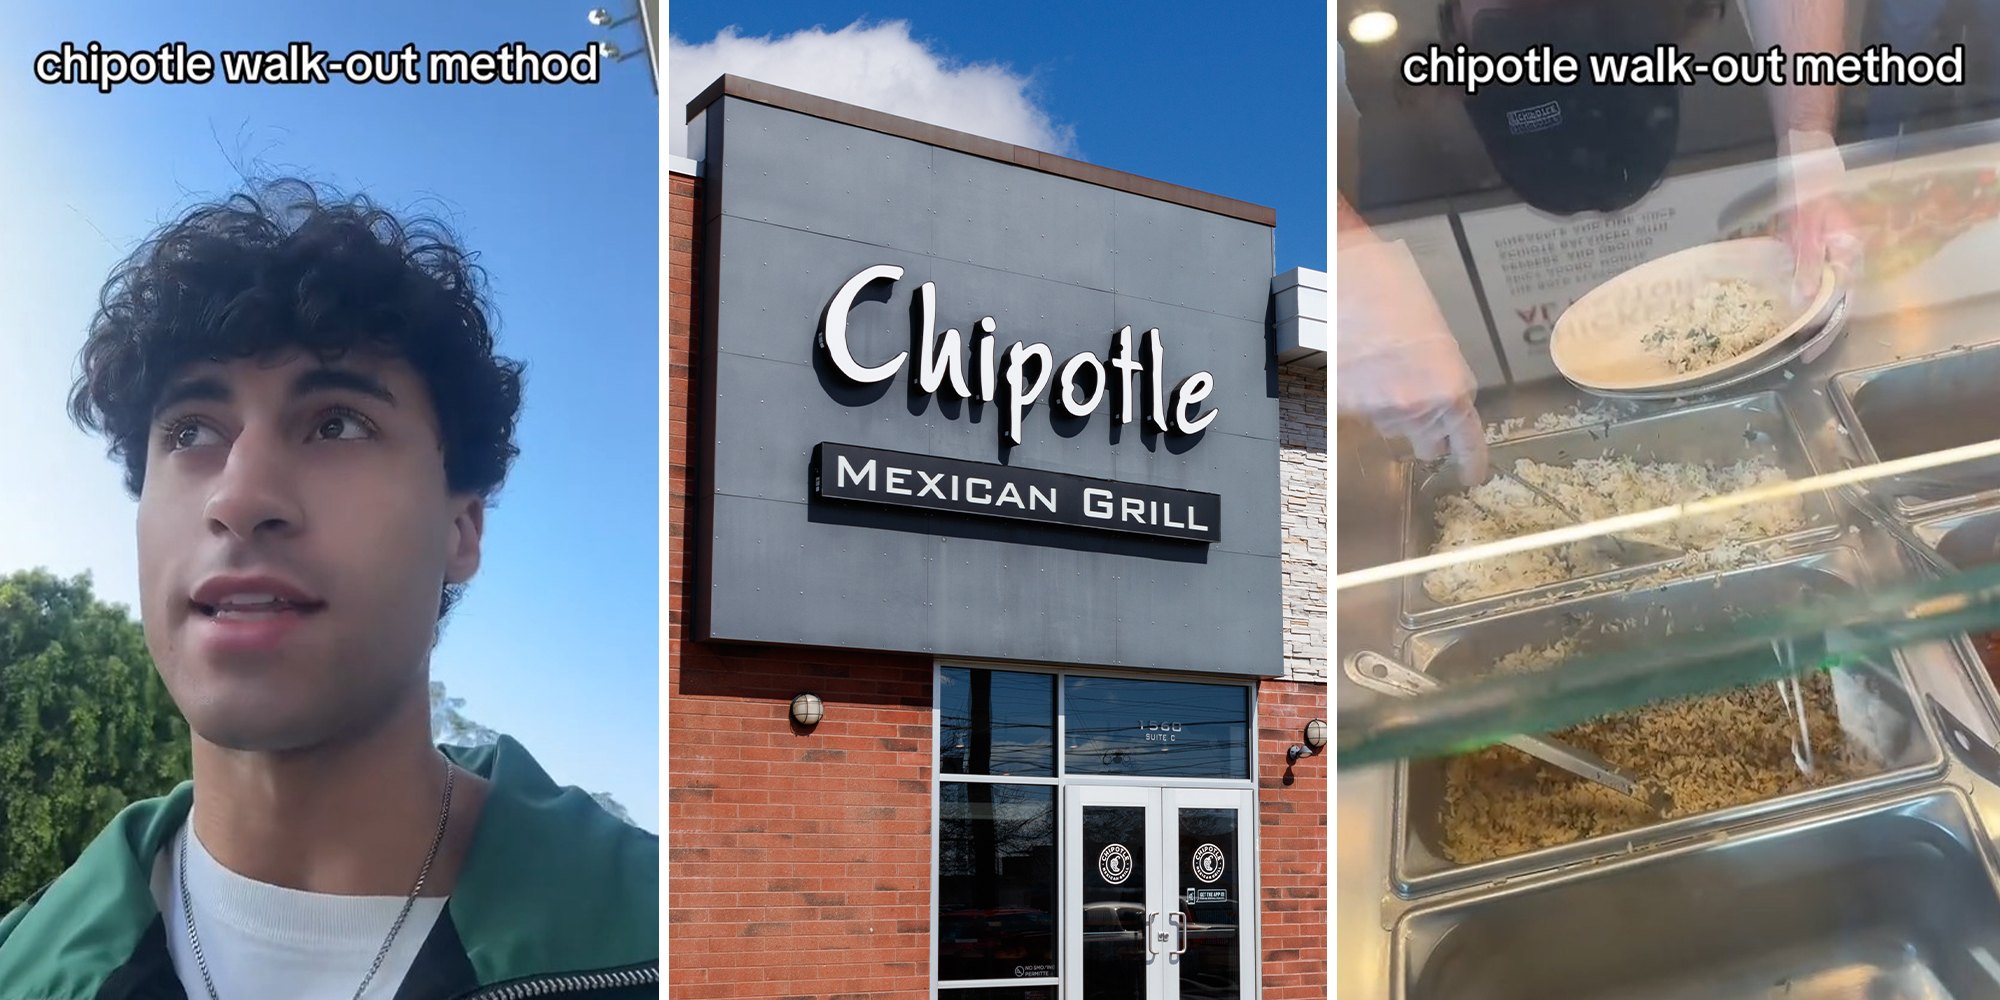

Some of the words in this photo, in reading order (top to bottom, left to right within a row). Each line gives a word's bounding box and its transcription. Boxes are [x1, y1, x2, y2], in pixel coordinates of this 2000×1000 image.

[824, 265, 1219, 445] Chipotle
[837, 455, 1057, 514] MEXICAN
[1083, 488, 1208, 531] GRILL
[1137, 720, 1182, 732] 1560
[1145, 733, 1167, 741] SUITE
[1101, 846, 1130, 862] CHIPOTLE
[1195, 846, 1222, 861] CHIPOTLE
